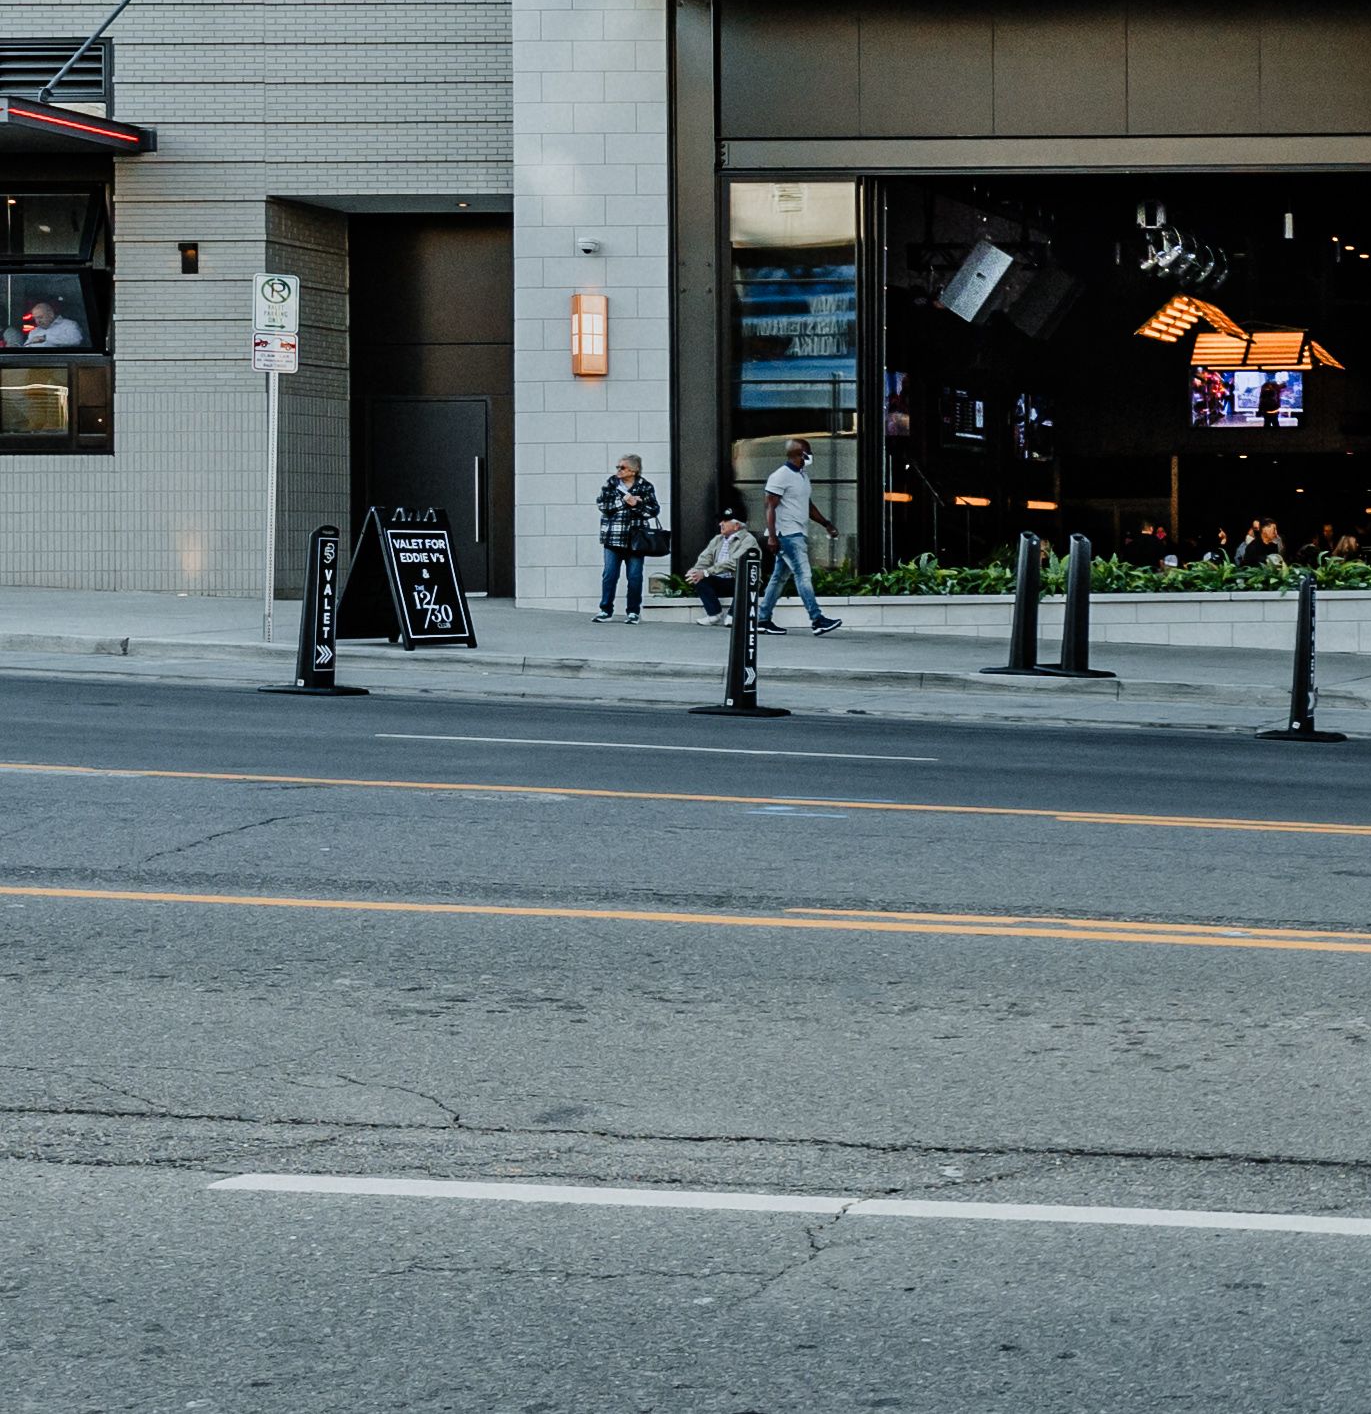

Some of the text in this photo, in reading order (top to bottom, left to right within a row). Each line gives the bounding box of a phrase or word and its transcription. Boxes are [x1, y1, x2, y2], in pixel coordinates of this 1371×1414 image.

[392, 539, 447, 550] VALET FOR
[400, 553, 445, 563] EDDIE V's
[422, 568, 430, 579] &
[323, 569, 333, 639] VALET
[748, 591, 757, 660] VALET
